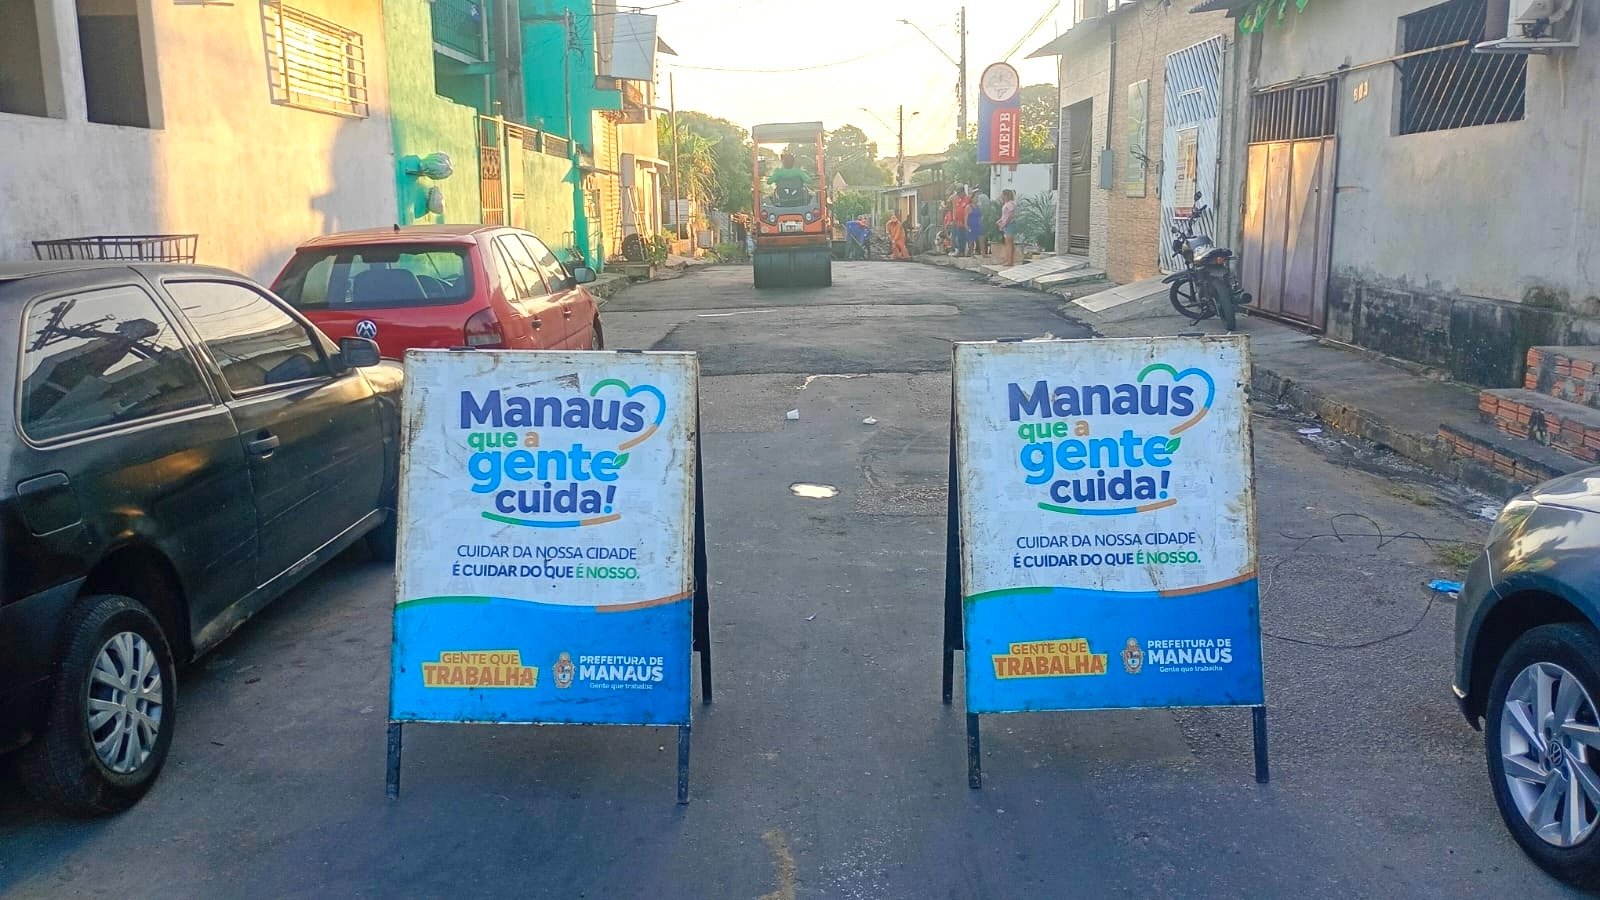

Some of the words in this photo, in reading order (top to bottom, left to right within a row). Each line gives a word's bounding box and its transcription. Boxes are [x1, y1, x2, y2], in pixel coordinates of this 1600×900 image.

[1008, 380, 1194, 422] Manaus
[460, 390, 647, 432] Manaus
[1018, 420, 1068, 443] que
[1073, 419, 1090, 436] a
[467, 430, 518, 452] que
[524, 430, 540, 447] a
[1020, 429, 1174, 485] gente
[468, 443, 620, 494] gente
[1050, 469, 1170, 503] cuida!
[495, 482, 617, 514] cuida!
[1016, 535, 1068, 549] CUIDAR
[1072, 534, 1092, 547] DA
[1095, 533, 1142, 547] NOSSA
[1145, 532, 1196, 545] CIDADE
[457, 545, 509, 558] CUIDAR
[512, 545, 533, 558] DA
[536, 546, 583, 559] NOSSA
[586, 547, 637, 560] CIDADE
[1013, 553, 1021, 568] É
[1023, 554, 1078, 568] CUIDAR
[1081, 553, 1102, 566] DO
[1105, 552, 1134, 567] QUE
[1136, 549, 1144, 565] É
[1146, 551, 1201, 564] NOSSO.
[452, 560, 461, 576] É
[462, 564, 518, 577] CUIDAR
[520, 565, 542, 577] DO
[544, 565, 574, 579] QUE
[576, 563, 584, 578] É
[586, 566, 640, 579] NOSSO.
[1011, 642, 1056, 655] GENTE
[1058, 642, 1087, 653] QUE
[1147, 639, 1215, 649] PREFEITURA
[1217, 638, 1232, 648] DE
[442, 653, 490, 664] GENTE
[493, 653, 519, 665] QUE
[580, 656, 648, 665] PREFEITURA
[650, 656, 664, 666] DE
[995, 654, 1105, 676] TRABALHA
[1148, 647, 1233, 665] MANAUS
[424, 665, 534, 686] TRABALHA
[579, 665, 664, 682] MANAUS
[1180, 666, 1194, 674] que
[1194, 665, 1223, 673] trabalha
[589, 682, 610, 690] Gente
[611, 683, 624, 691] que
